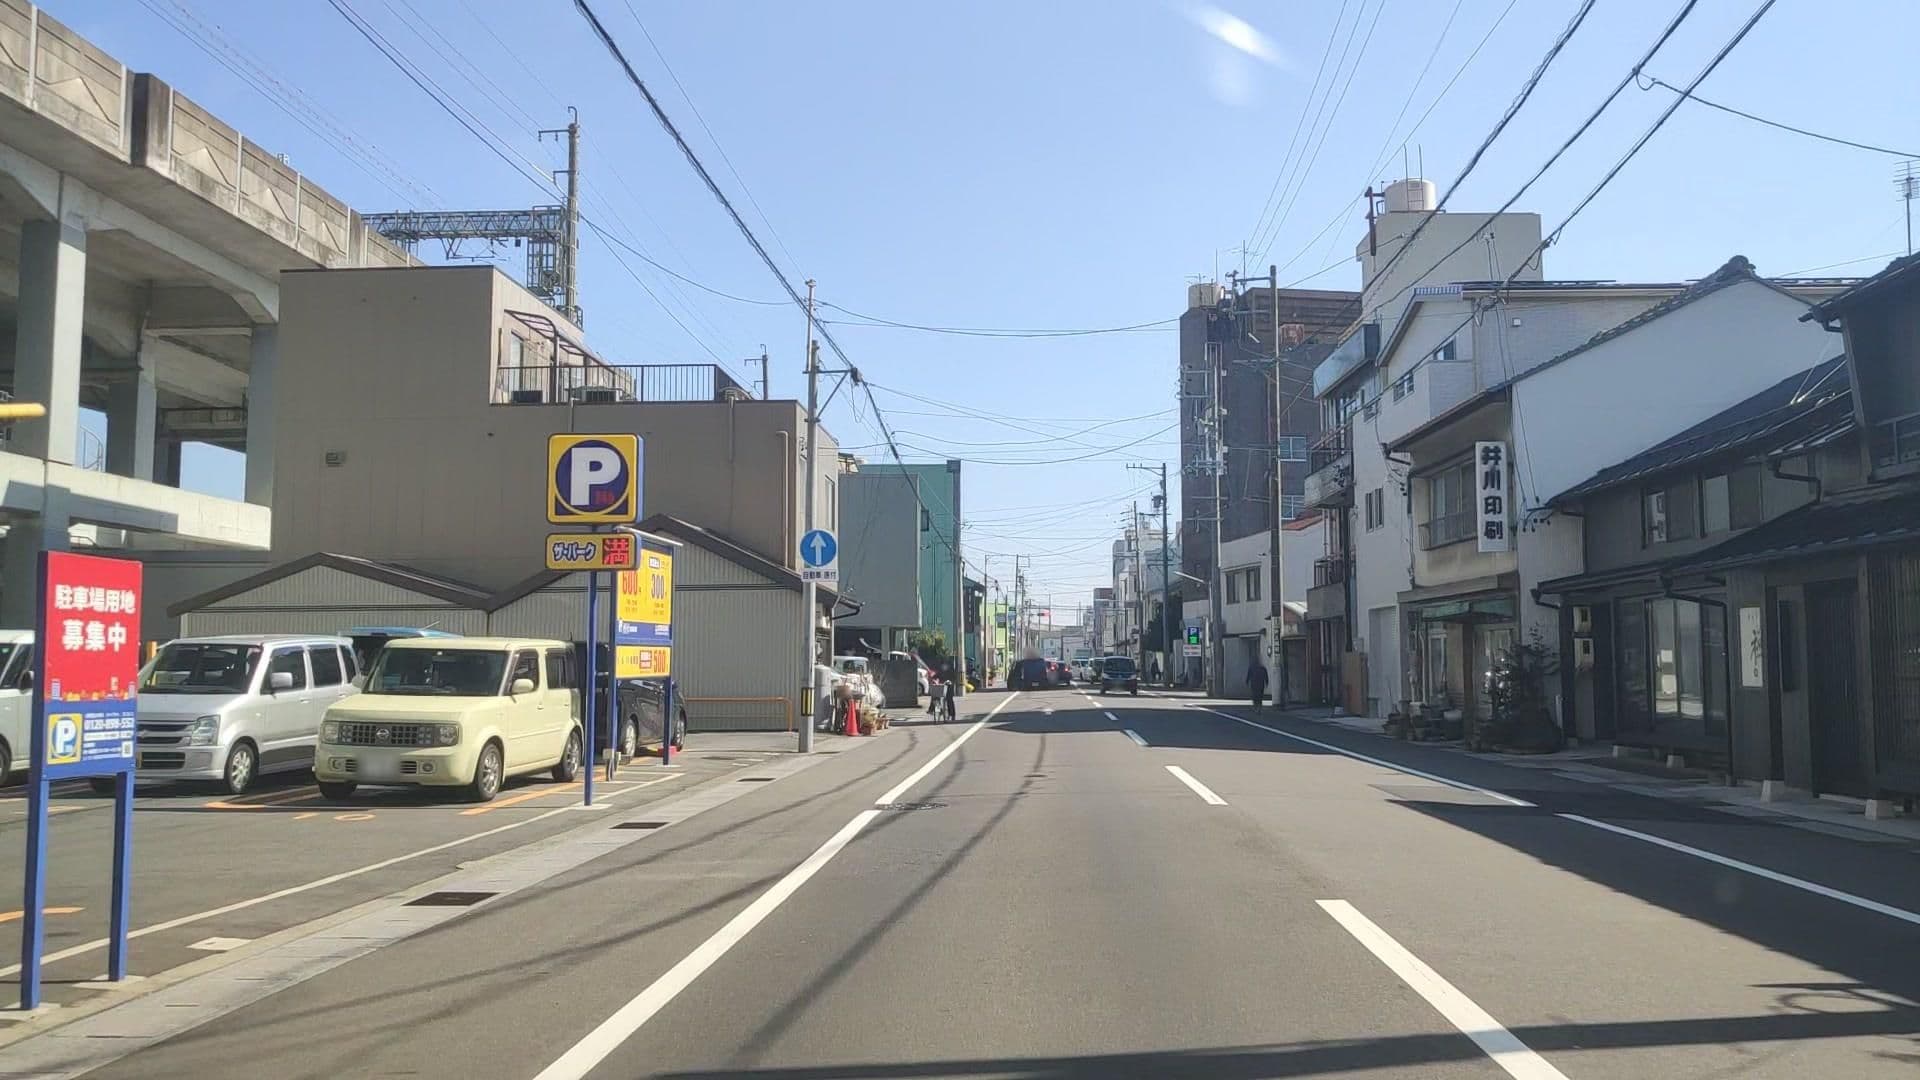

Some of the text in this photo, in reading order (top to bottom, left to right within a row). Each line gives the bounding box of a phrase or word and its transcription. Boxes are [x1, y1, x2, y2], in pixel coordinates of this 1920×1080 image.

[570, 447, 621, 506] P
[1481, 445, 1504, 540] 井川印刷
[603, 539, 629, 565] 満
[55, 584, 136, 614] 駐車場用地
[651, 573, 665, 599] 300
[62, 618, 127, 652] 募集中
